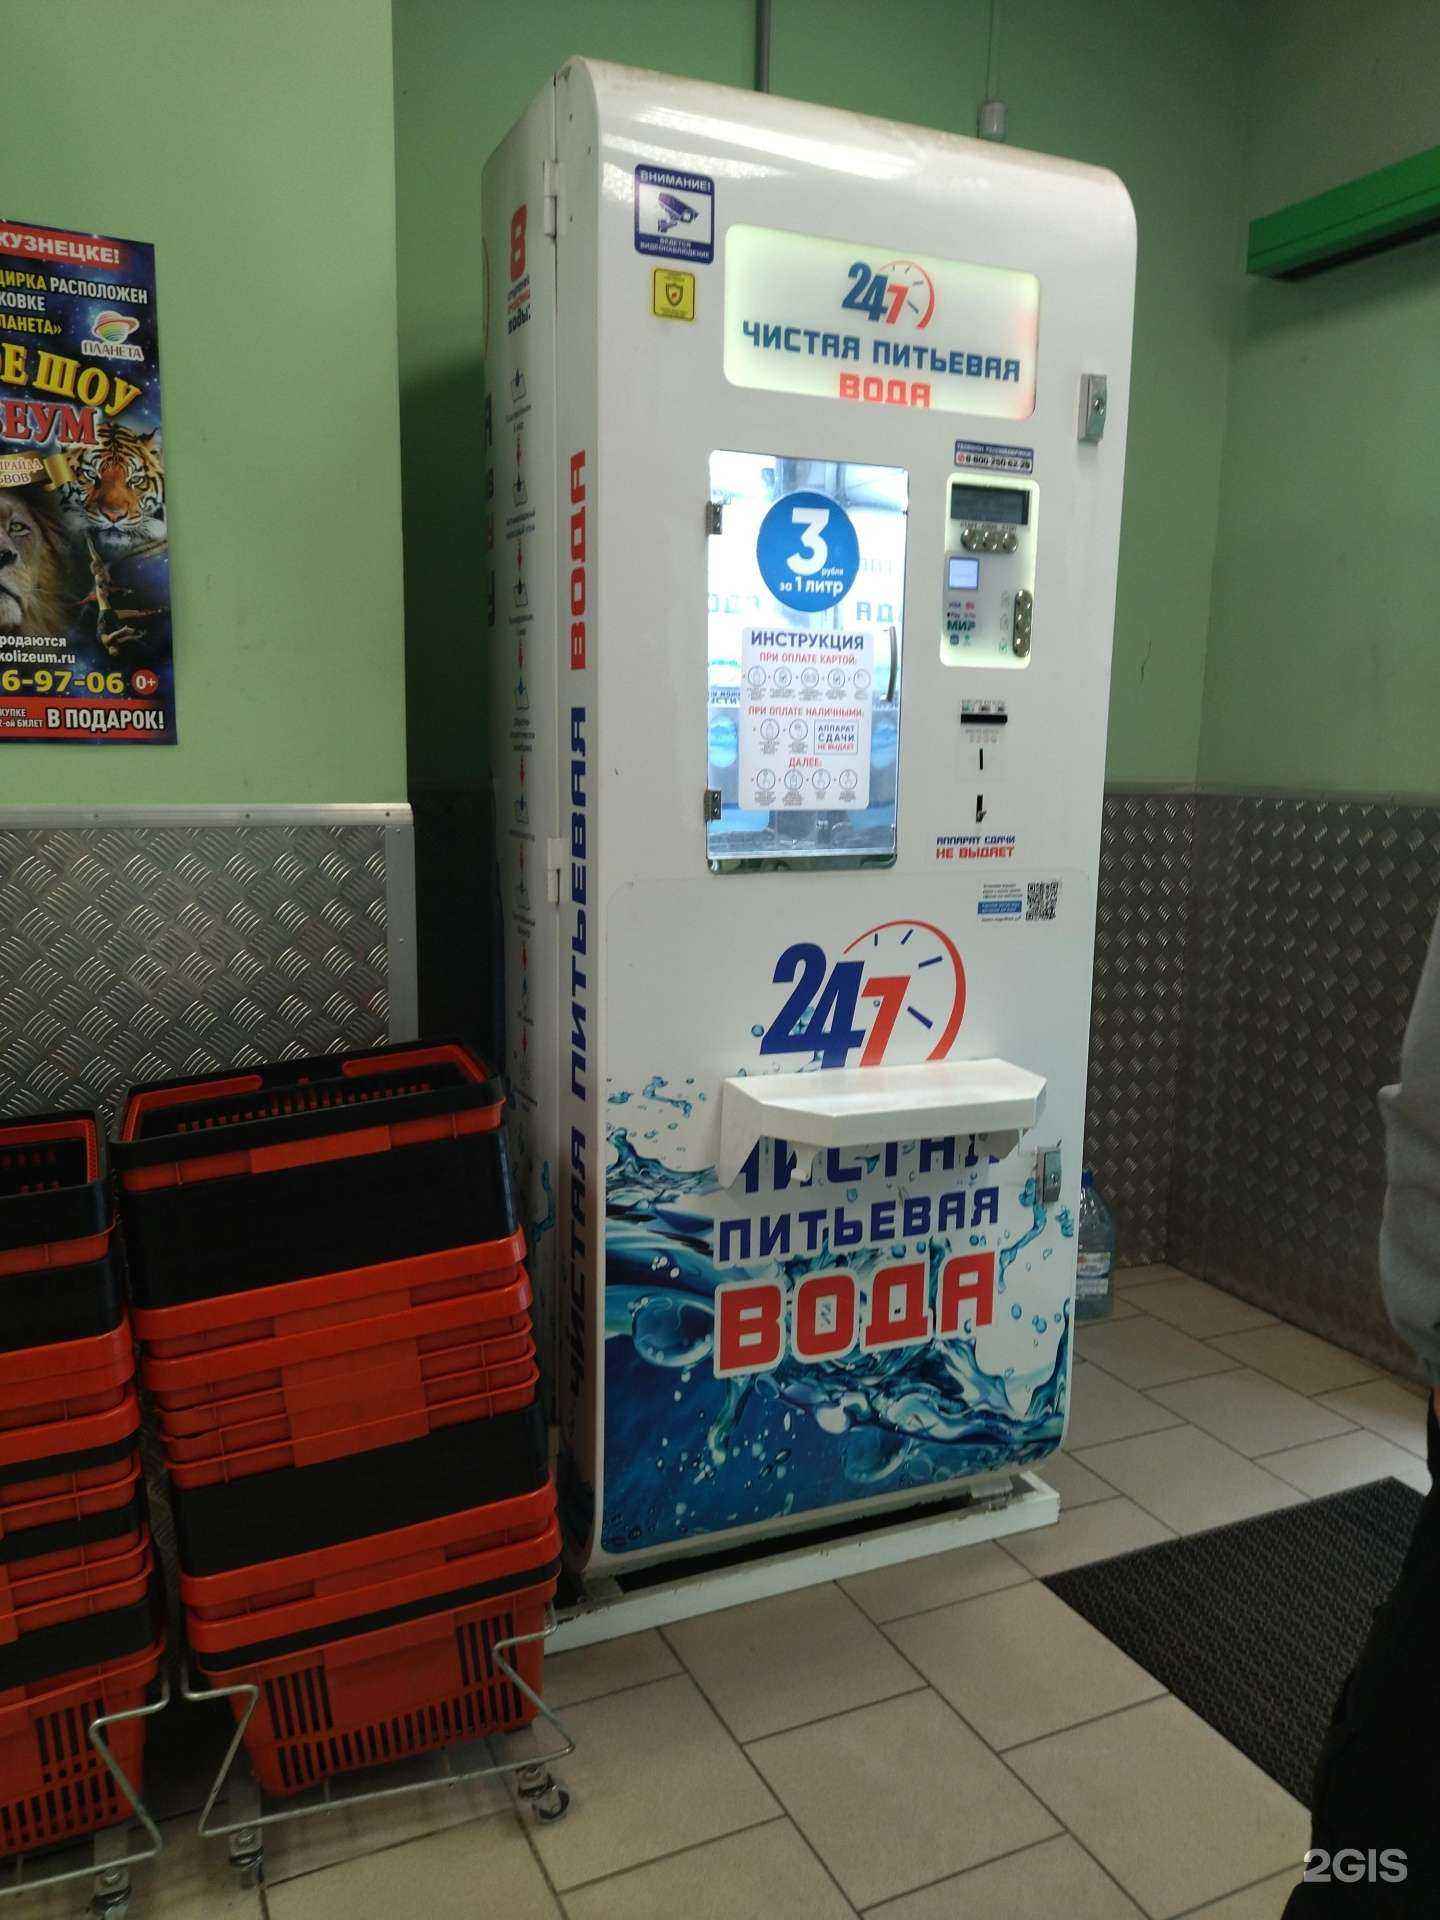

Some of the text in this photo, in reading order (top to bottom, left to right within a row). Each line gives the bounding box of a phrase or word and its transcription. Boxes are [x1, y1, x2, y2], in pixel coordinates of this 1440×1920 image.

[50, 277, 148, 305] РАСПОЛОЖЕН
[742, 320, 1021, 383] ЧИСТАЯ ПИТЬЕВАЯ
[34, 351, 142, 417] ШОУ
[839, 372, 931, 408] ВОДА
[786, 507, 830, 576] 3
[570, 450, 586, 671] ВОДА
[795, 577, 802, 592] 1
[805, 578, 844, 597] литр
[0, 635, 66, 648] родаются
[751, 631, 864, 652] ИНСТРУКЦИЯ
[760, 652, 779, 662] ПРИ
[782, 653, 816, 664] ОПЛАТЕ
[1, 669, 157, 695] 6-97-06 0+
[47, 708, 60, 728] В
[65, 709, 164, 732] ПОДАРОК!
[748, 706, 766, 716] ПРИ
[769, 706, 802, 717] ОПЛАТЕ
[818, 725, 855, 733] АППАРАТ
[818, 733, 855, 743] СДАЧИ
[936, 848, 954, 859] НЕ
[571, 707, 586, 1101] ПИТЬЕВАЯ
[719, 1186, 1000, 1263] ПИТЬЕВАЯ
[719, 1252, 996, 1370] ВОДА
